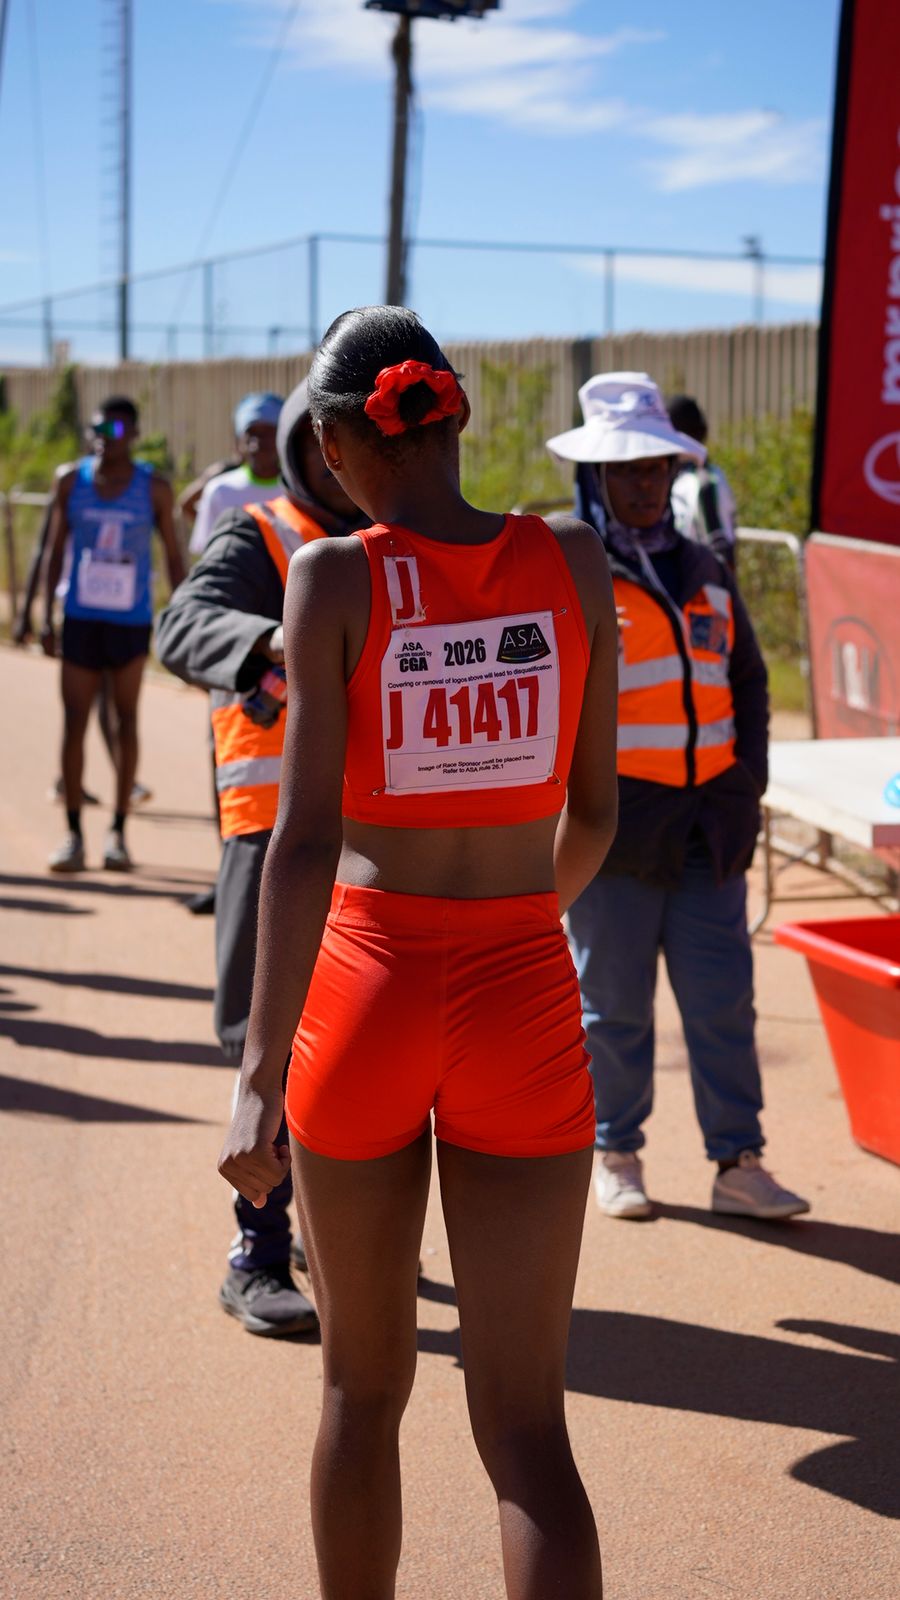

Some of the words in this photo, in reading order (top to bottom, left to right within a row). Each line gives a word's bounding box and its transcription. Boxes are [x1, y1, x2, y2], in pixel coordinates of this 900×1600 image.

[396, 560, 416, 620] J
[402, 642, 423, 652] ASA
[503, 628, 542, 649] ASA
[443, 637, 487, 667] 2026
[387, 680, 414, 689] Covering
[451, 676, 468, 685] logos
[467, 674, 484, 682] above
[483, 671, 494, 679] will
[513, 664, 552, 675] disqualification
[399, 657, 429, 673] CGA
[386, 690, 404, 750] J
[423, 675, 540, 747] 41417
[458, 760, 481, 768] Sponsor
[503, 755, 522, 763] placed
